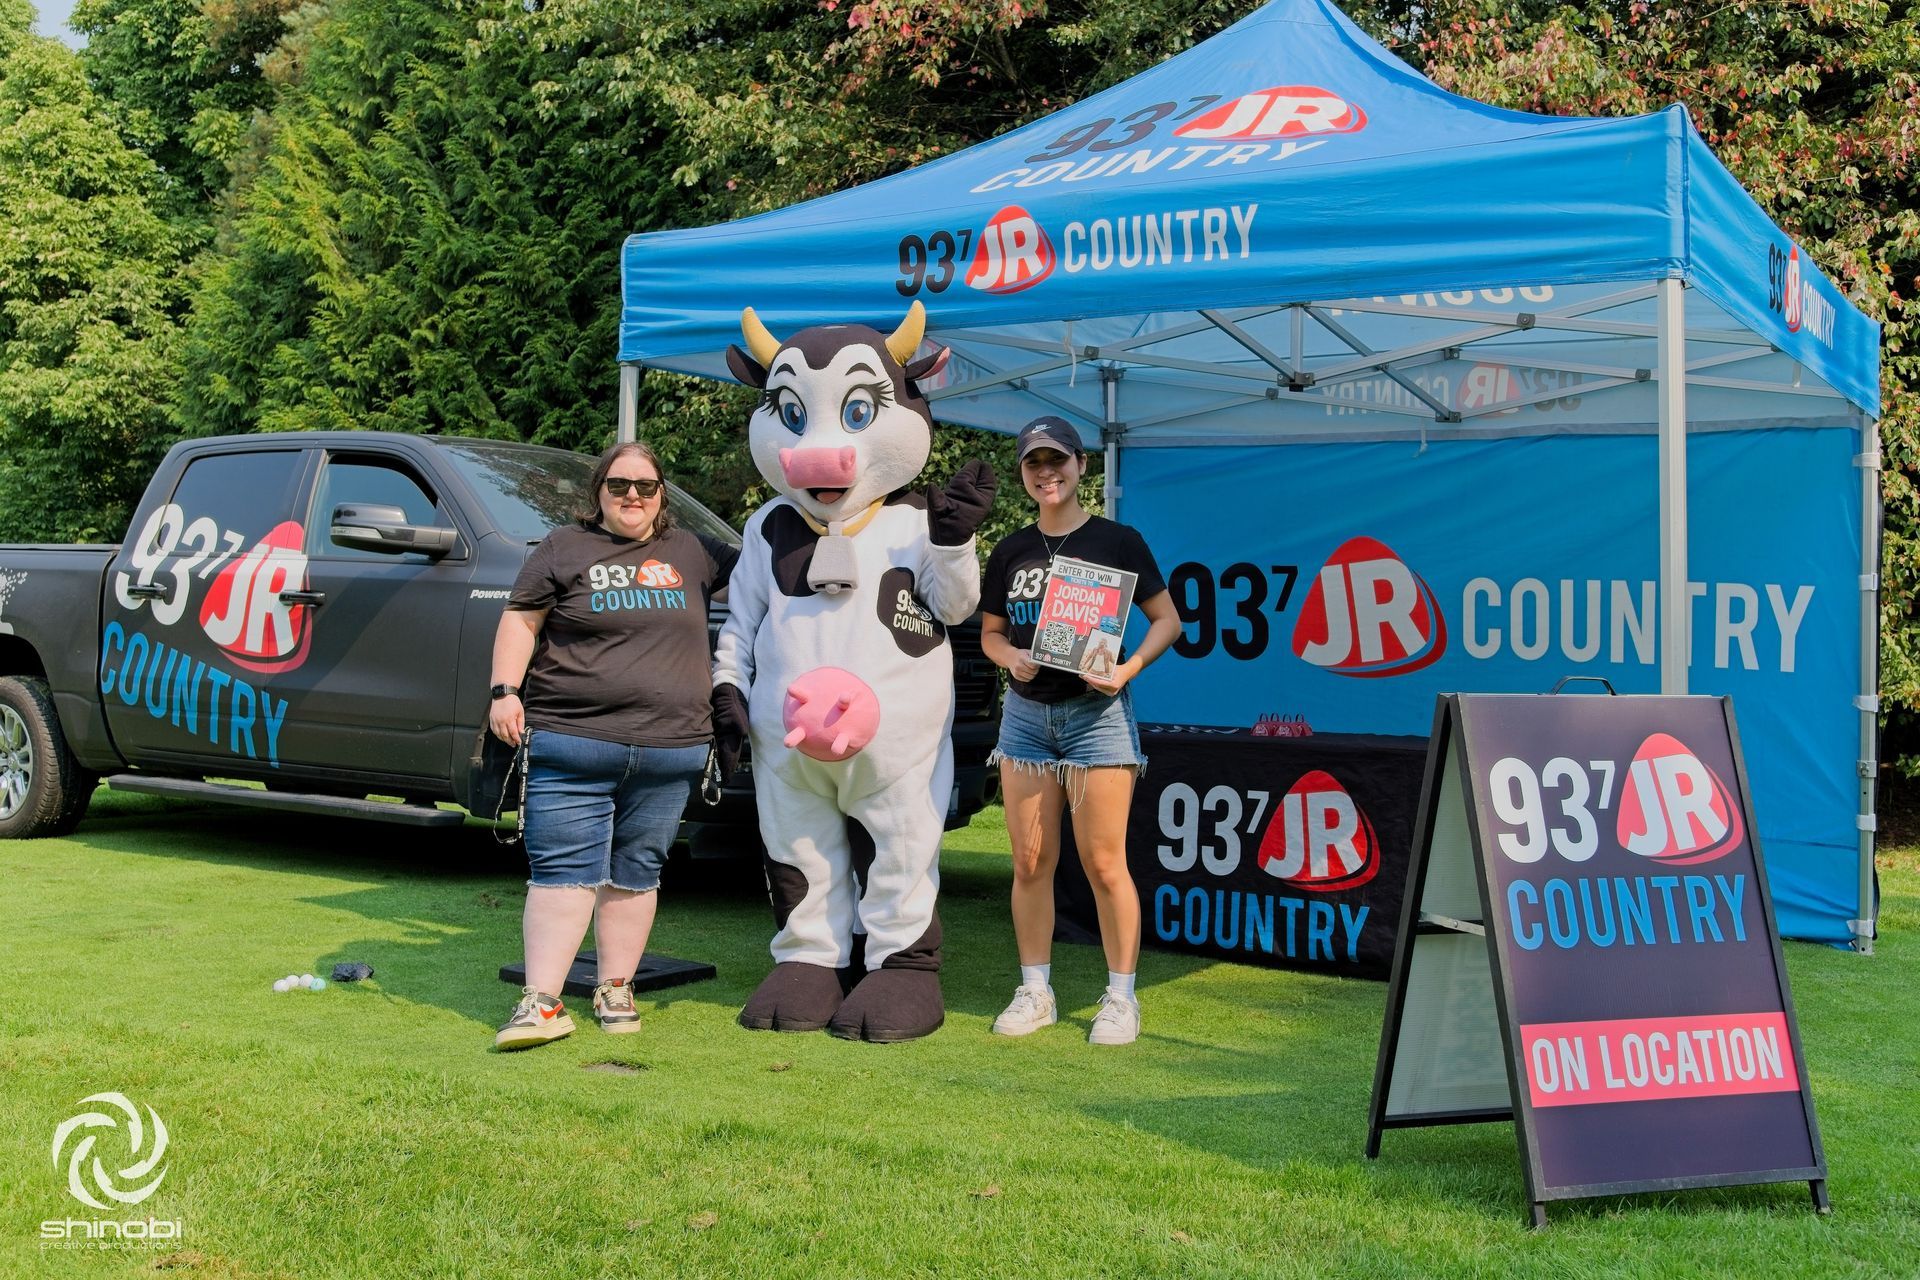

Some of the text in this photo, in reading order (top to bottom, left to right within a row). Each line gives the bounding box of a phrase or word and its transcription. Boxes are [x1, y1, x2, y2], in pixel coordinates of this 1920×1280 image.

[1178, 94, 1348, 140] JR
[970, 140, 1329, 193] COUNTRY
[968, 215, 1048, 290] JR
[1063, 204, 1259, 273] COUNTRY
[1802, 280, 1836, 351] COUNTRY
[203, 546, 309, 657] JR
[591, 589, 687, 613] COUNTRY
[637, 562, 680, 587] JR
[1053, 585, 1105, 607] JORDAN
[1058, 564, 1113, 583] ENTER TO WIN
[893, 613, 934, 638] COUNTRY
[1051, 599, 1100, 625] DAVIS
[1300, 557, 1427, 668] JR
[101, 620, 289, 769] COUNTRY
[1052, 657, 1072, 667] COUNTRY
[1264, 790, 1365, 879] JR
[1624, 754, 1730, 857] JR
[1154, 883, 1370, 963] COUNTRY
[1507, 874, 1746, 951] COUNTRY
[1531, 1027, 1785, 1093] ON LOCATION
